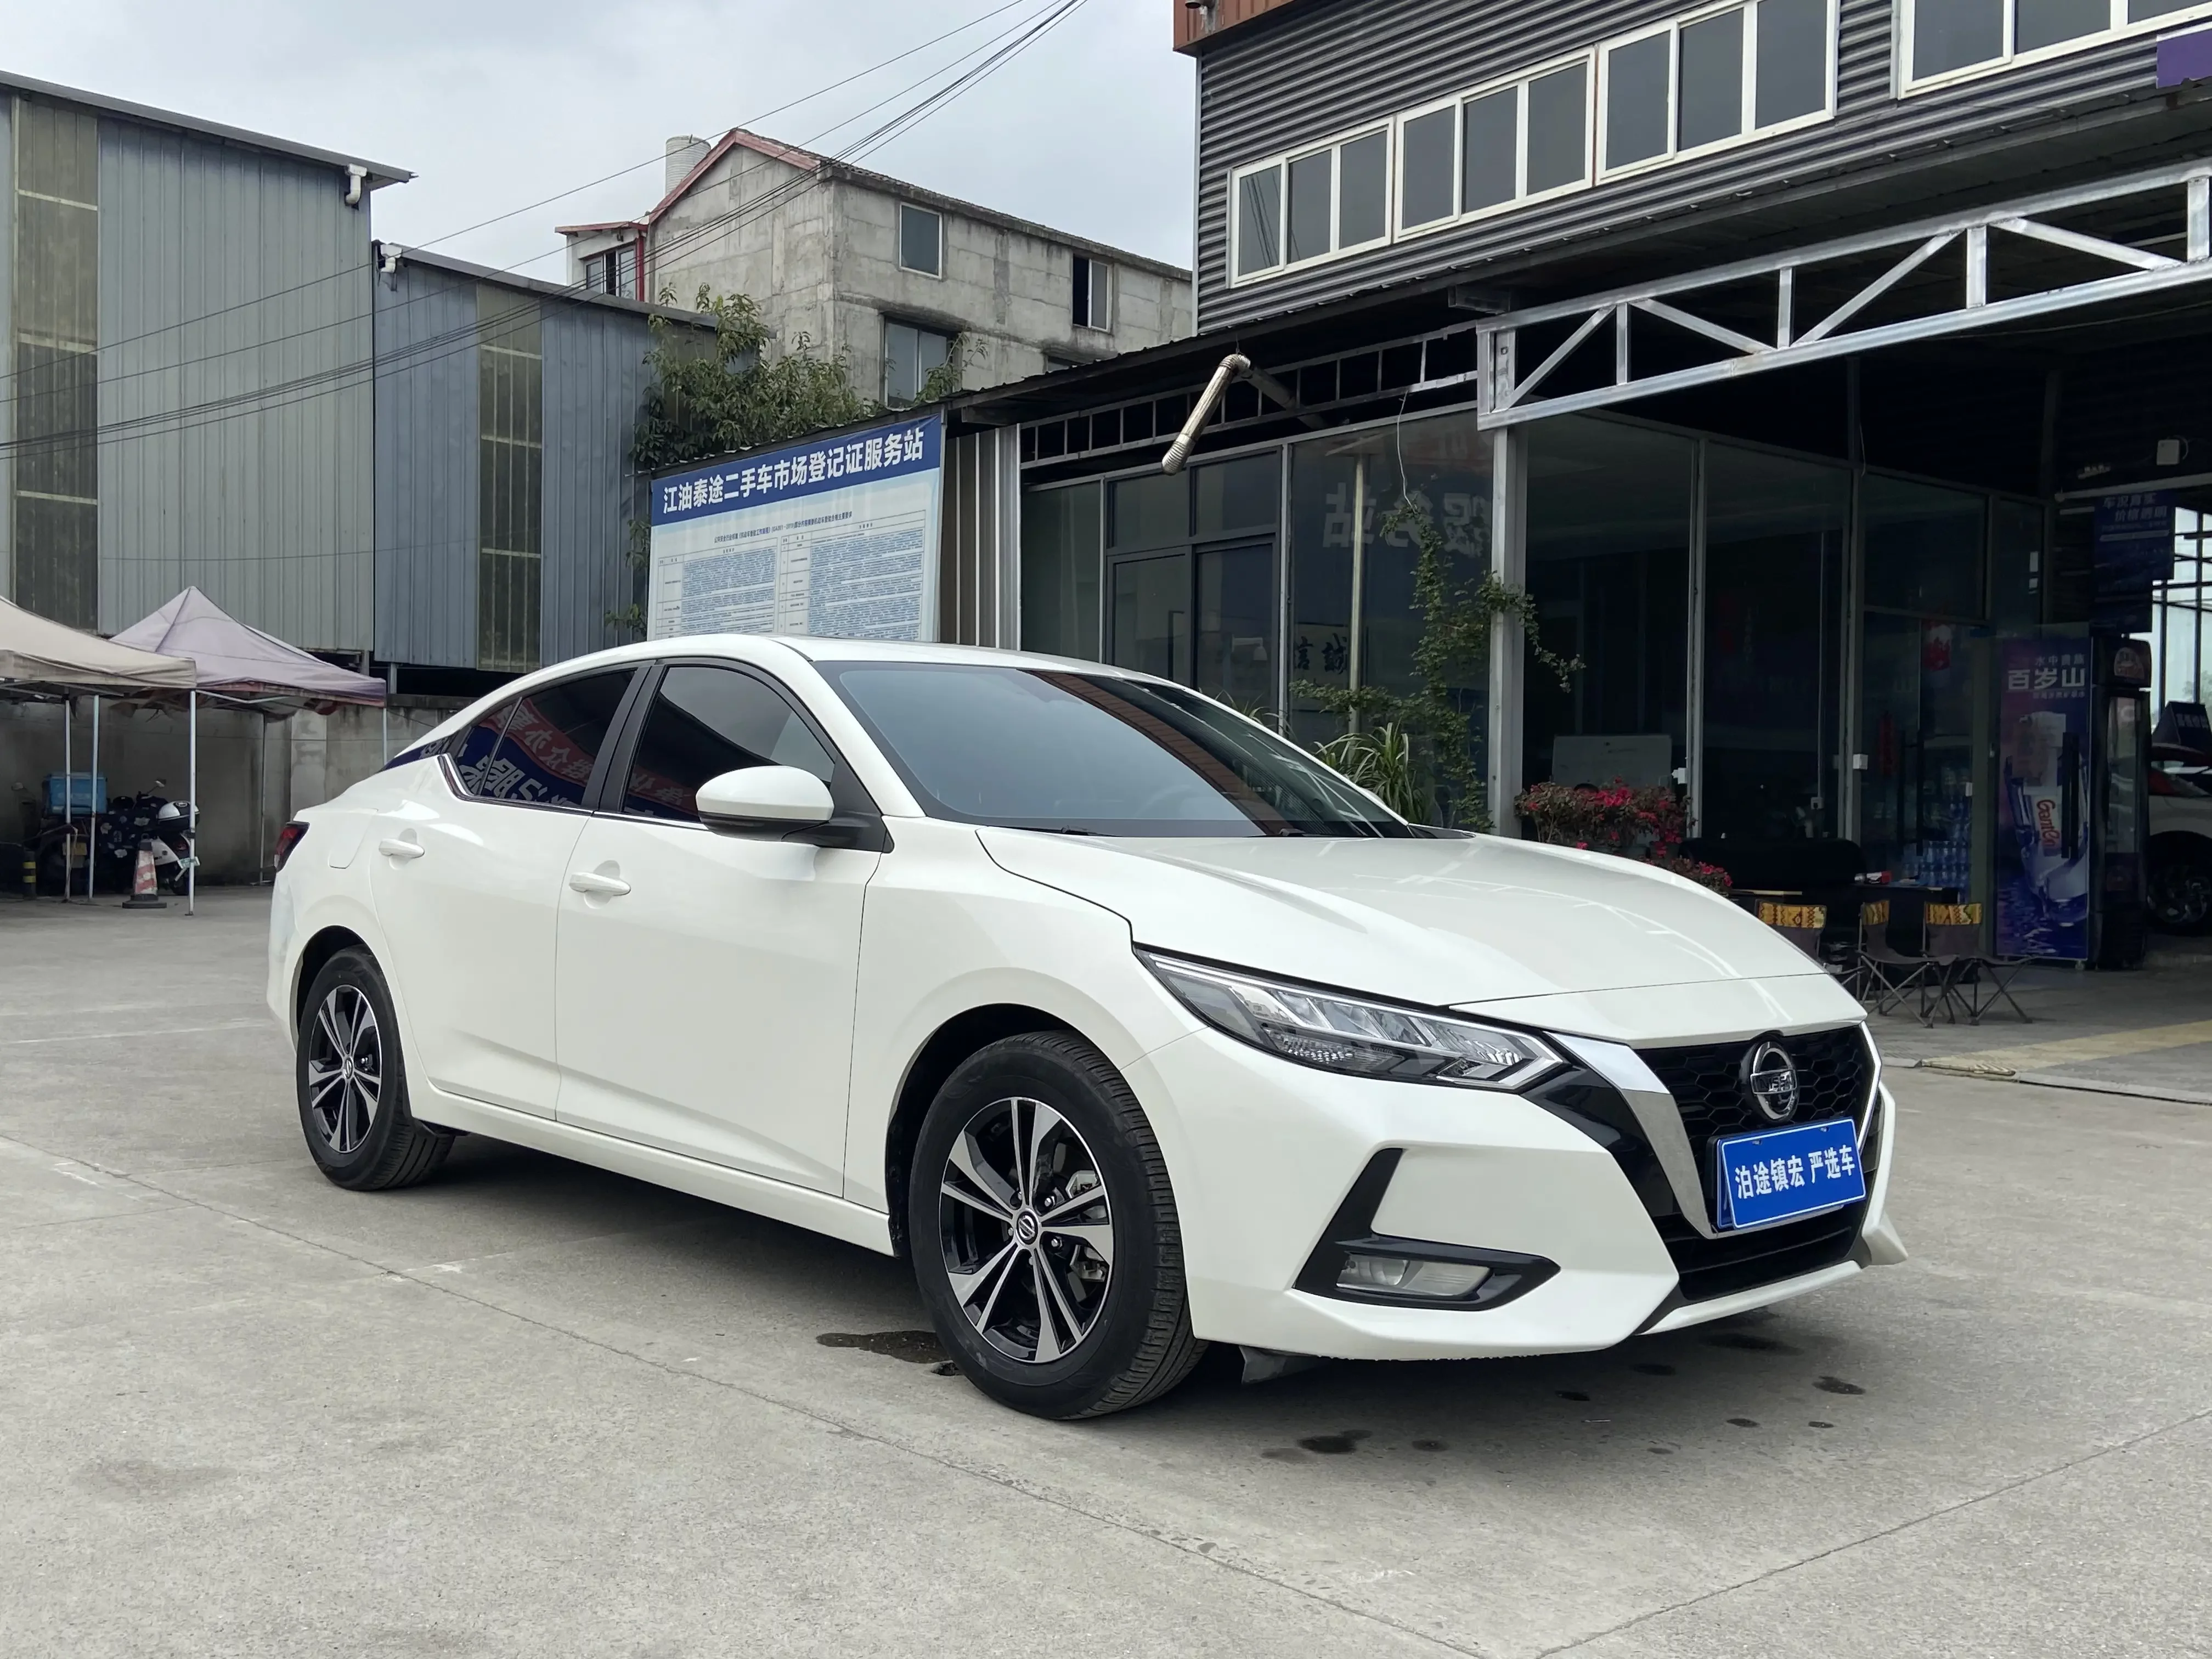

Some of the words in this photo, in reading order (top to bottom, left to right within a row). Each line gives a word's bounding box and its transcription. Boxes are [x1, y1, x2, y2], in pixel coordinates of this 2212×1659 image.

[663, 427, 924, 515] 江油泰途二手车市场登记证服务站
[2008, 667, 2085, 690] 百岁山
[1735, 1155, 1805, 1199] 泊途镇宏
[1808, 1144, 1855, 1183] 严选车
